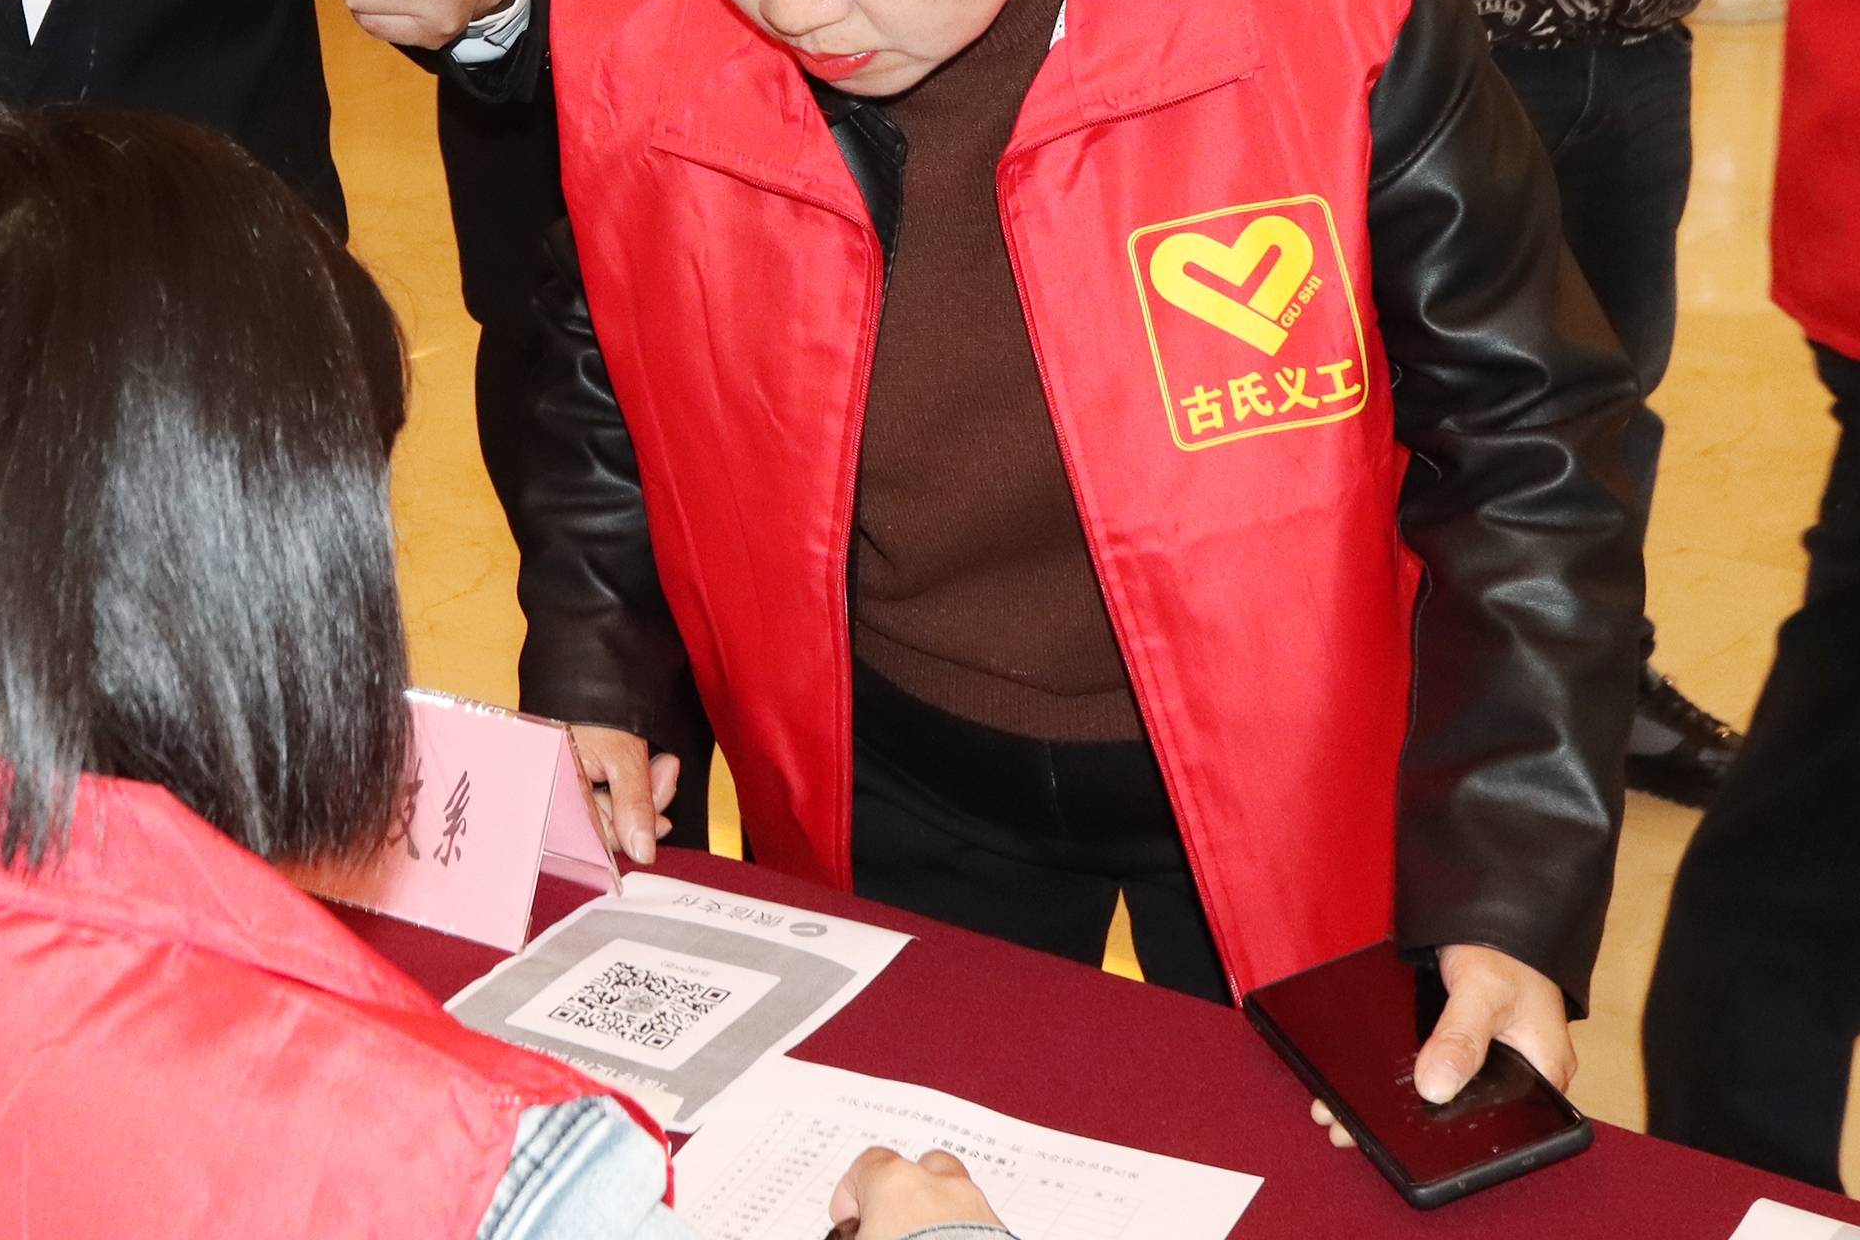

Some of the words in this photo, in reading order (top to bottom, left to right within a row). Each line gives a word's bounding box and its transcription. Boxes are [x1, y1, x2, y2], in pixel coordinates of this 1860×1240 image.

[1280, 303, 1303, 328] GU
[1299, 275, 1322, 304] SHI
[1179, 359, 1361, 435] 古氏义工
